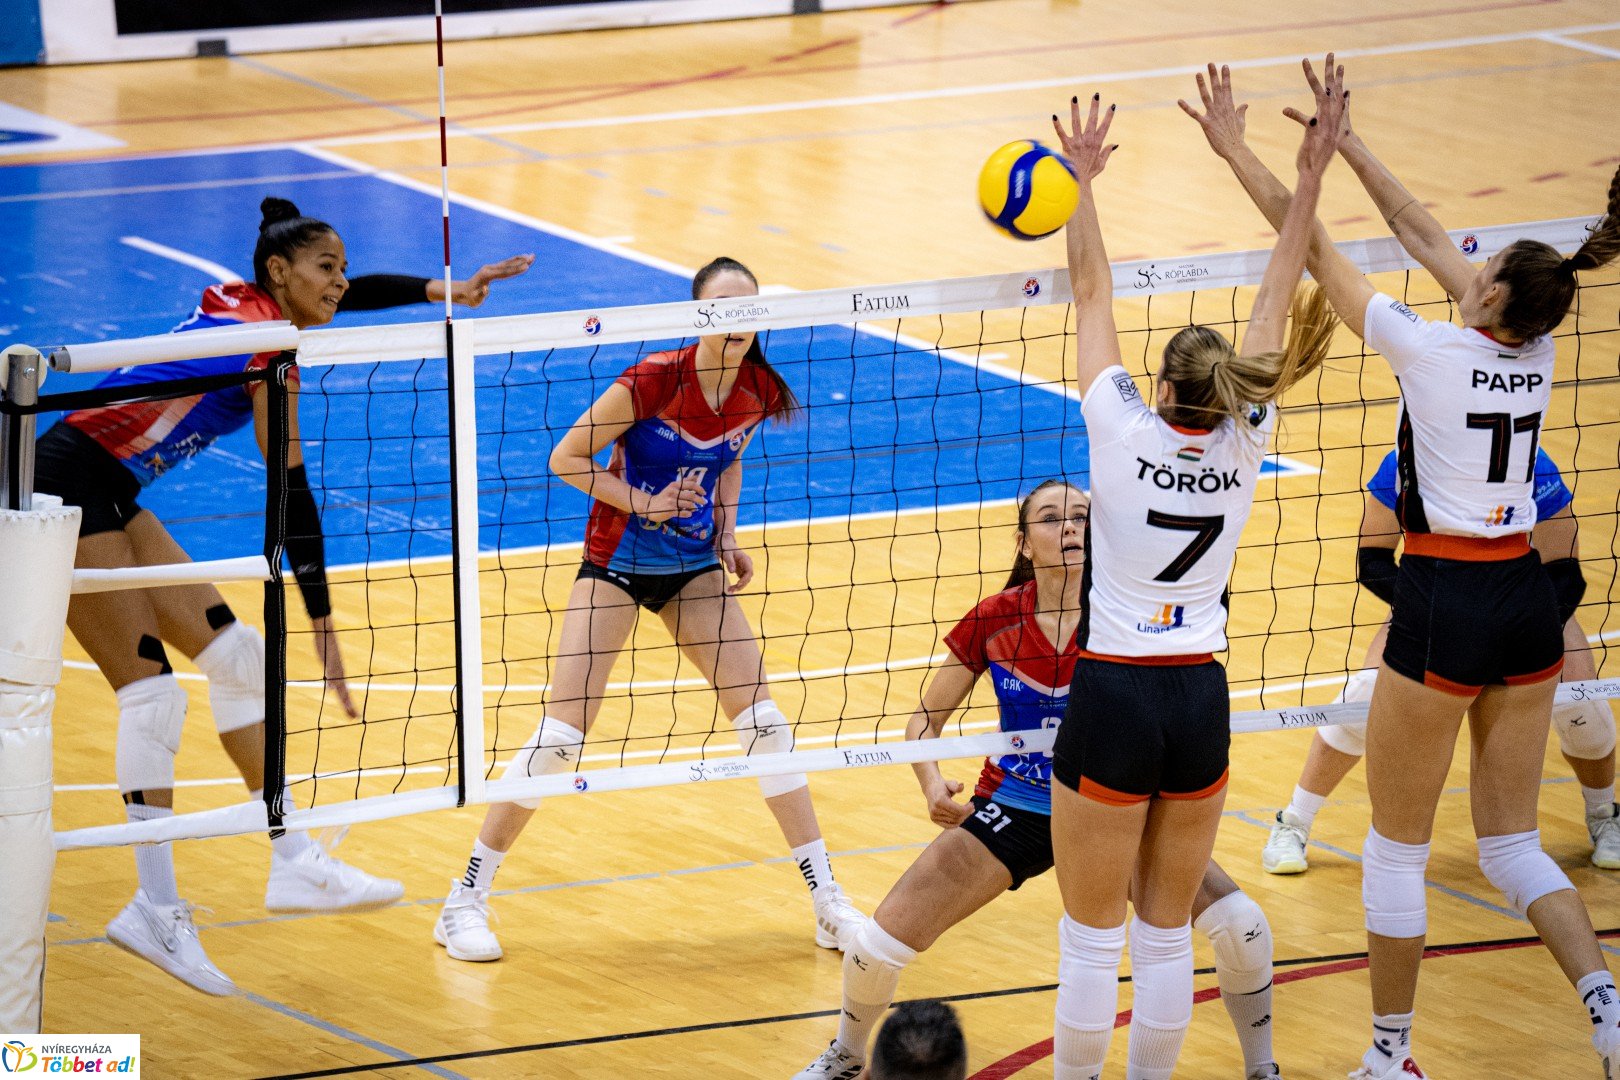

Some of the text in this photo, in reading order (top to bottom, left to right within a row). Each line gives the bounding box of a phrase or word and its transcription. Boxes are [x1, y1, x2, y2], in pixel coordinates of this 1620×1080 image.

[1165, 268, 1209, 279] RÖPLABDA
[851, 291, 910, 311] FATUM
[725, 307, 770, 318] RÖPLABDA
[1471, 368, 1544, 394] PAPP
[1136, 456, 1242, 494] TÖRÖK
[1146, 507, 1225, 583] 7
[1277, 710, 1329, 725] FATUM
[843, 750, 893, 765] FATUM
[974, 802, 1012, 833] 21
[1594, 984, 1613, 1006] nine
